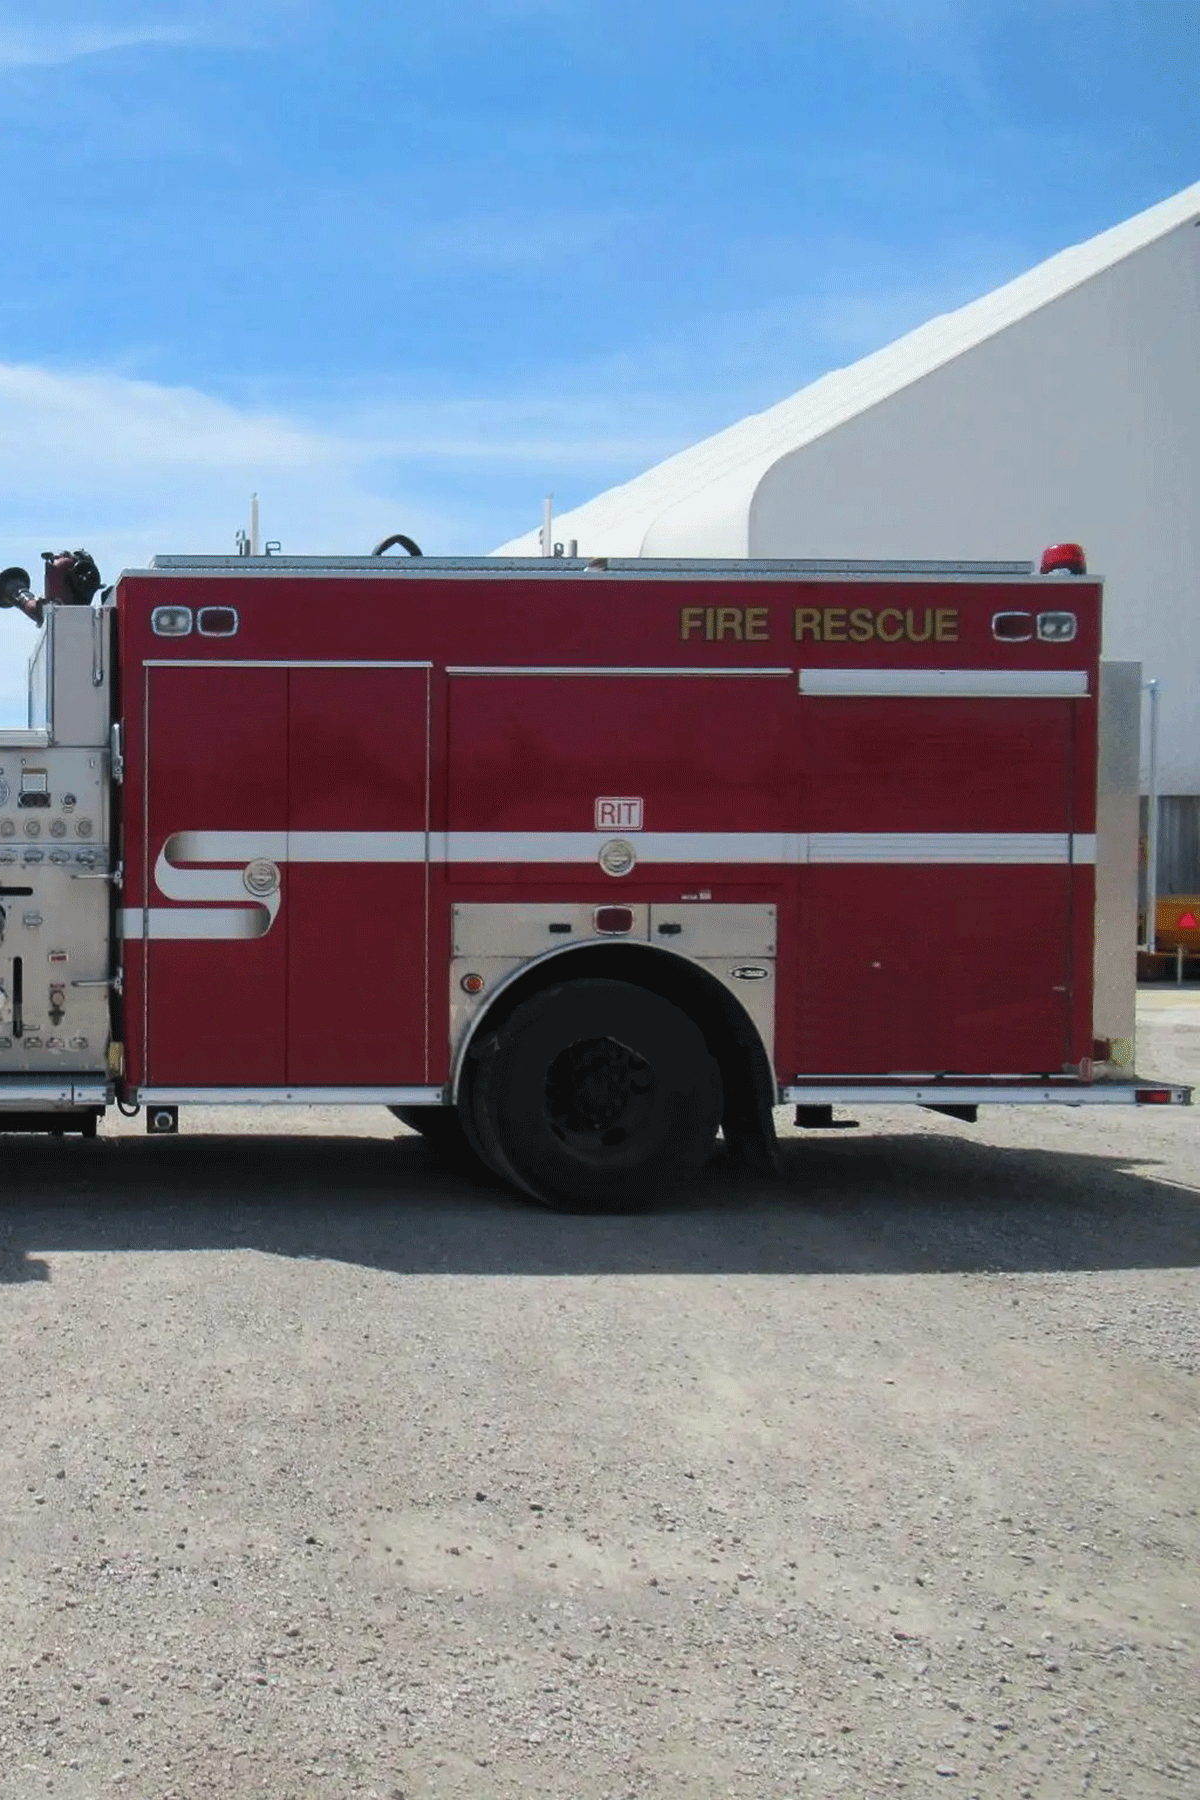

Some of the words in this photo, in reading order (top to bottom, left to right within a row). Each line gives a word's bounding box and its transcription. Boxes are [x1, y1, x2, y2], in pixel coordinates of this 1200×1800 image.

[680, 606, 770, 641] FIRE
[794, 607, 960, 642] RESCUE
[601, 802, 637, 824] RIT
